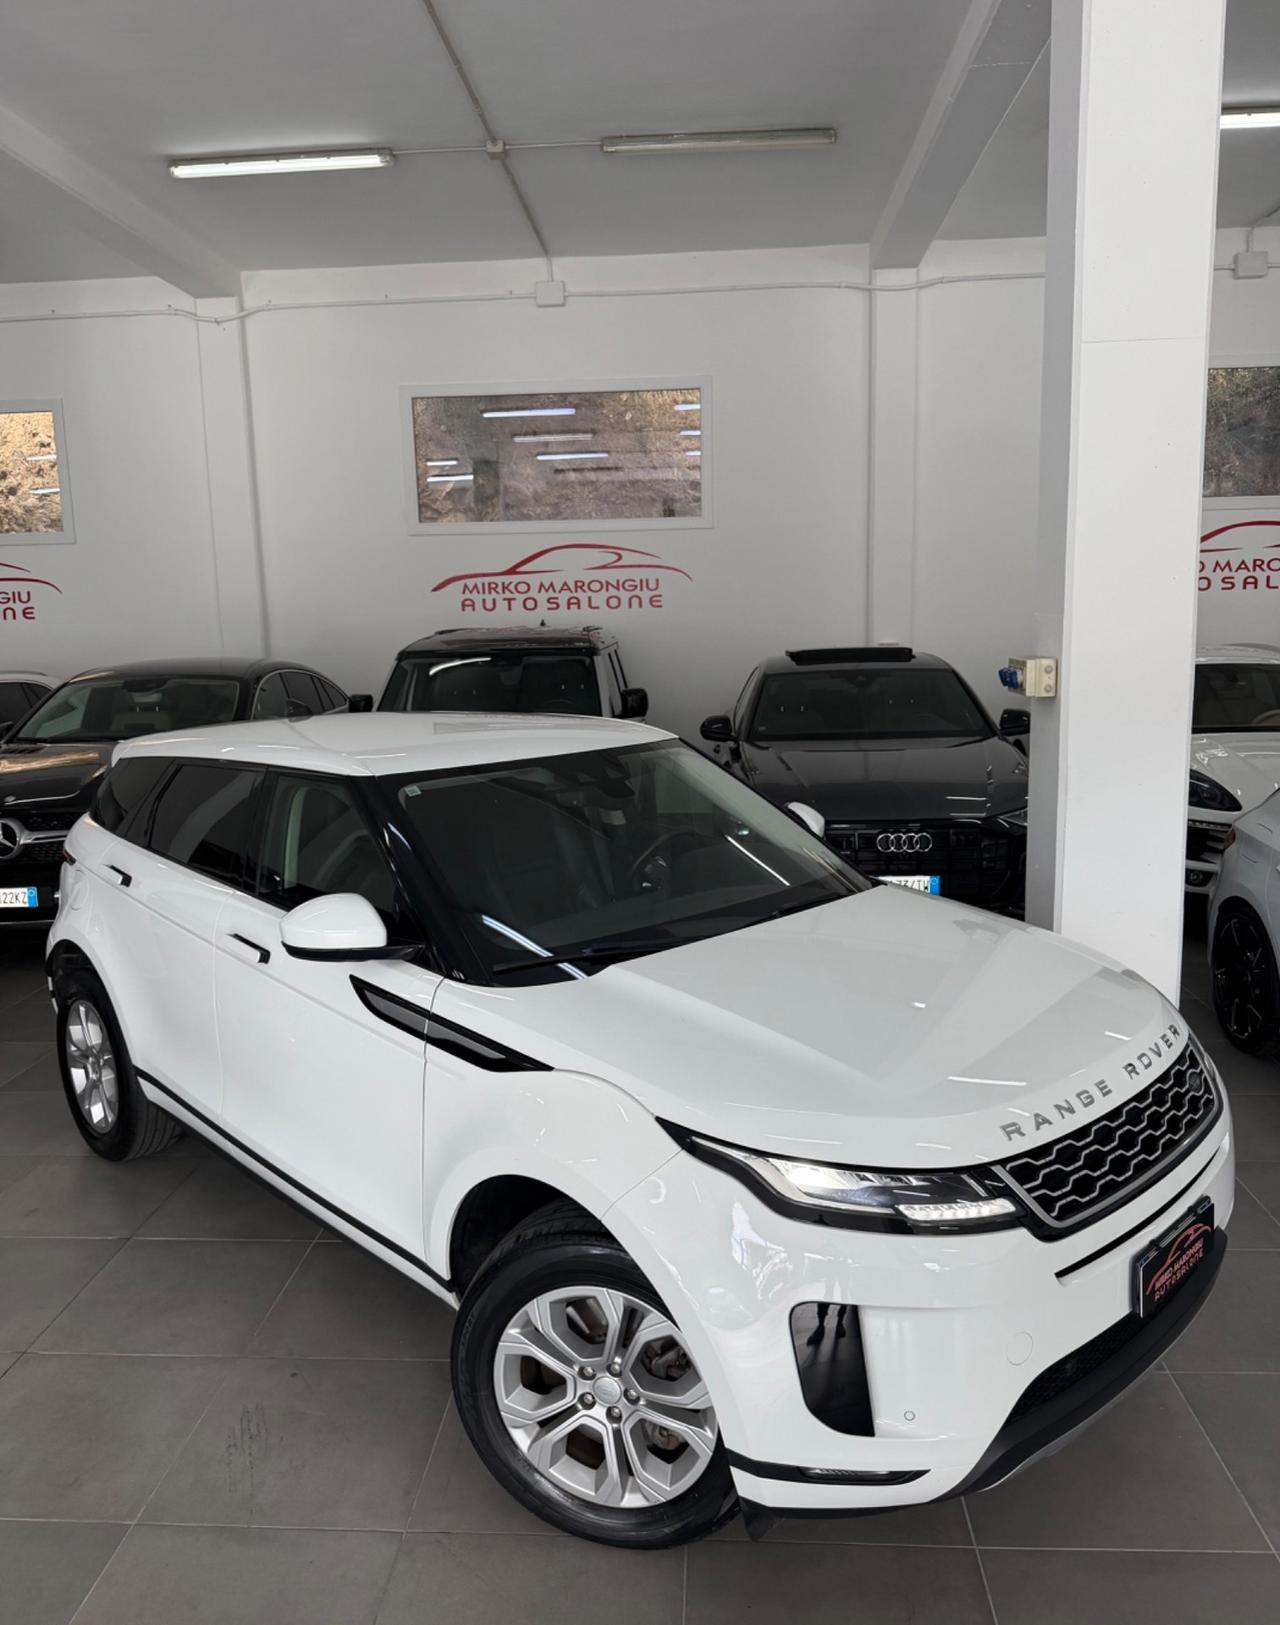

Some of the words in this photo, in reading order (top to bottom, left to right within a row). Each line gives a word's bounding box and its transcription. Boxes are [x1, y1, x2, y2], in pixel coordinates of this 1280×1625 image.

[461, 580, 531, 595] MIRKO
[537, 578, 660, 594] MARONGIU
[461, 594, 664, 612] AUTOSALONE
[0, 891, 27, 905] 22KZ
[999, 1079, 1113, 1141] RANGE
[1121, 1024, 1181, 1080] ROVER
